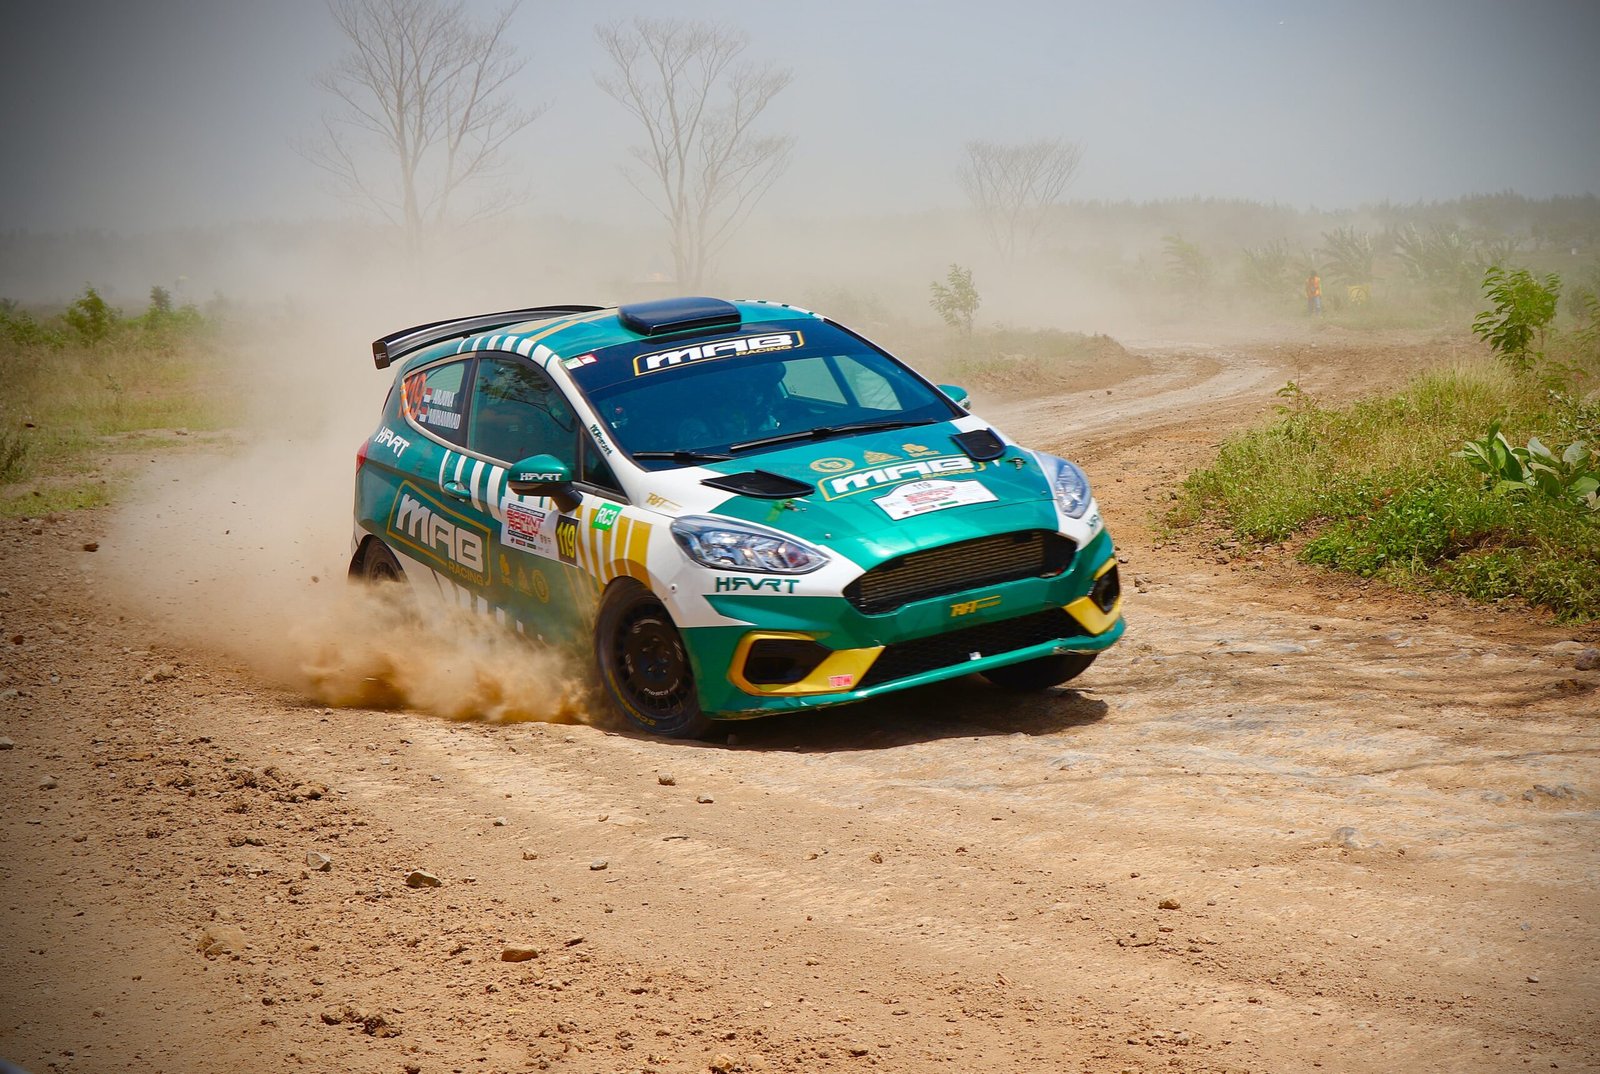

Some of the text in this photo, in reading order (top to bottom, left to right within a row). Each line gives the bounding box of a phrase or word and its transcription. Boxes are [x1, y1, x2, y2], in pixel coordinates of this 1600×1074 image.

[647, 334, 793, 370] MAB RACING
[831, 456, 977, 494] MAB RACING
[506, 509, 545, 529] SPRINT
[594, 507, 616, 526] RC3
[396, 493, 485, 587] MAB RACING
[556, 521, 576, 558] 119
